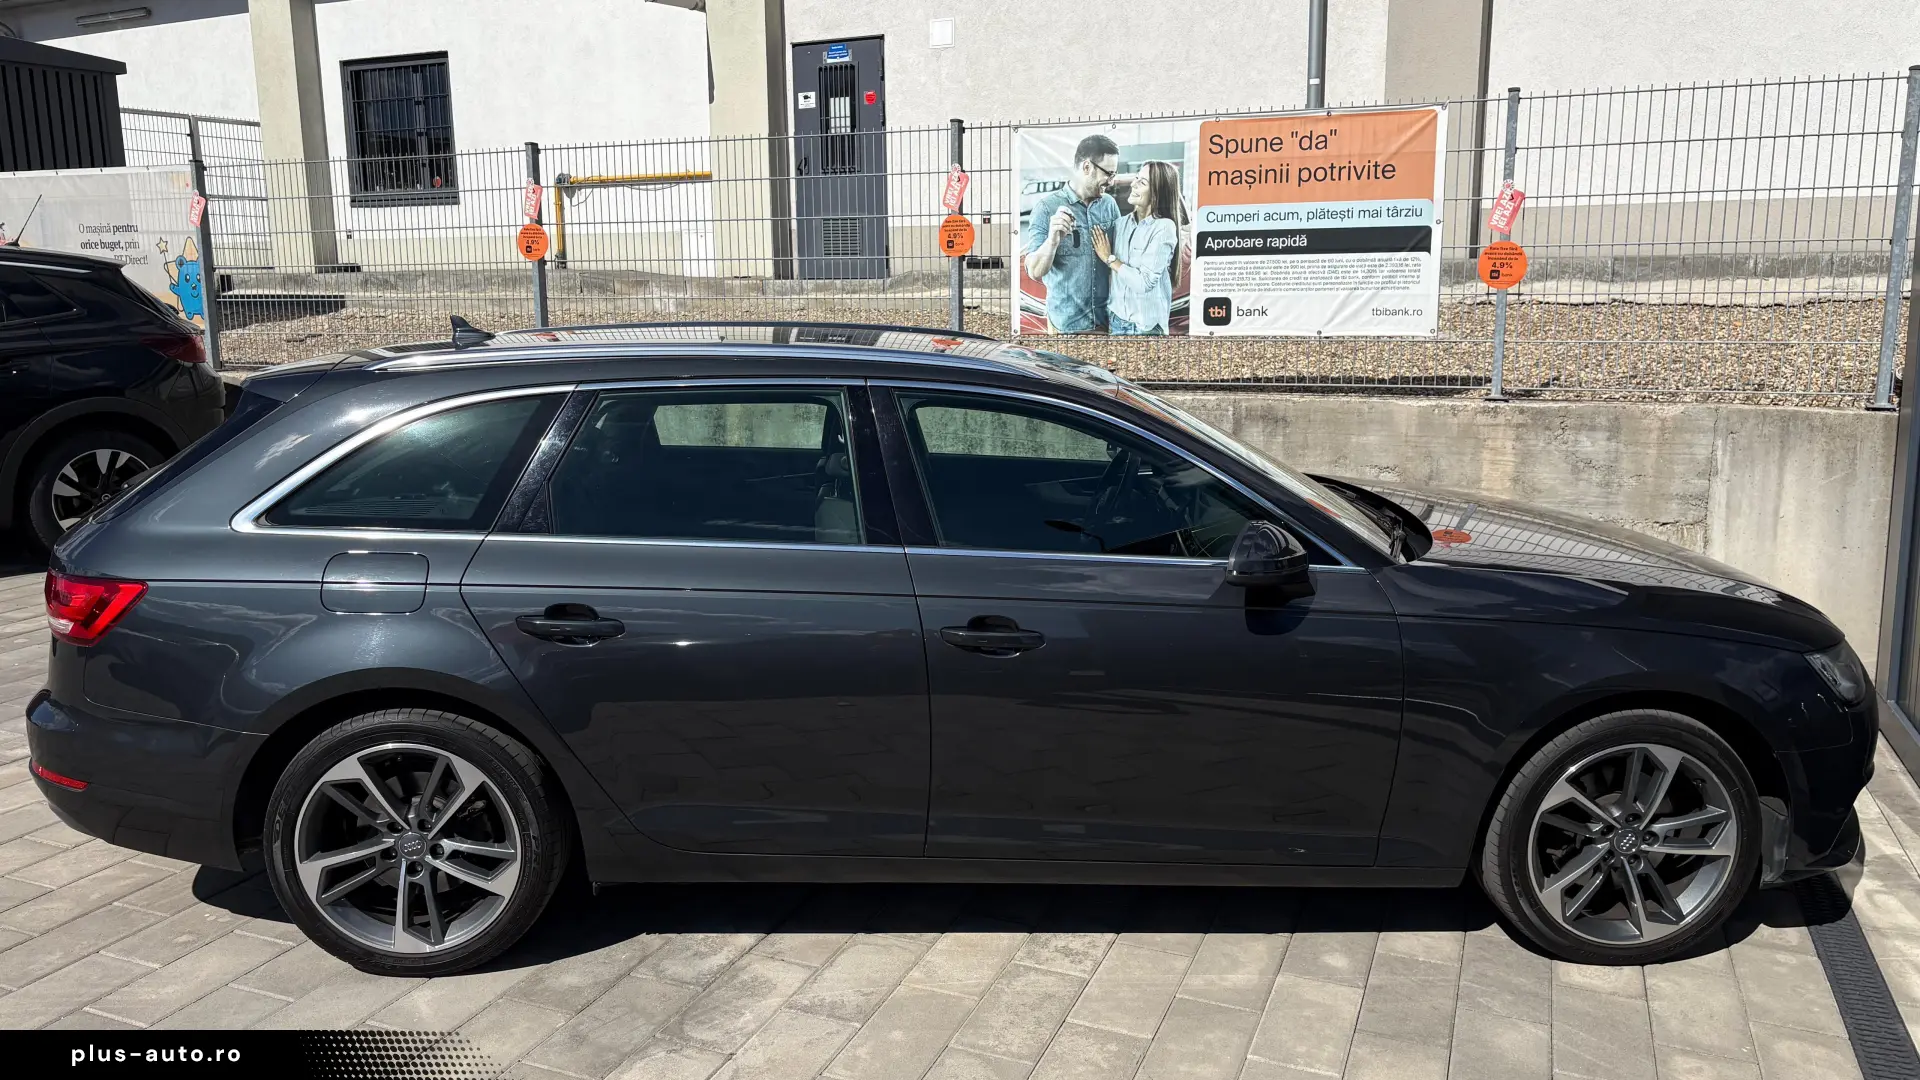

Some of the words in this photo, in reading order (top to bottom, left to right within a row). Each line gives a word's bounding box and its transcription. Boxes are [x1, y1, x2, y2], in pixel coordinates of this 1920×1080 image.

[1208, 134, 1284, 158] Spune
[1291, 128, 1338, 151] "da"
[1208, 163, 1290, 190] mașinii
[1298, 160, 1396, 187] potrivite
[1206, 210, 1260, 225] Cumperi
[1263, 210, 1303, 224] acum,
[1306, 206, 1354, 224] plătești
[1358, 207, 1382, 218] mai
[1386, 204, 1424, 218] târziu
[79, 224, 84, 234] O
[86, 223, 111, 236] mașină
[113, 224, 138, 235] pentru
[80, 240, 99, 250] orice
[100, 239, 124, 252] buget,
[125, 239, 140, 251] prin
[1204, 236, 1263, 250] Aprobare
[1266, 234, 1307, 249] rapidă
[1208, 306, 1226, 318] tbi
[1236, 306, 1268, 316] bank
[1372, 306, 1423, 316] tbibank.ro
